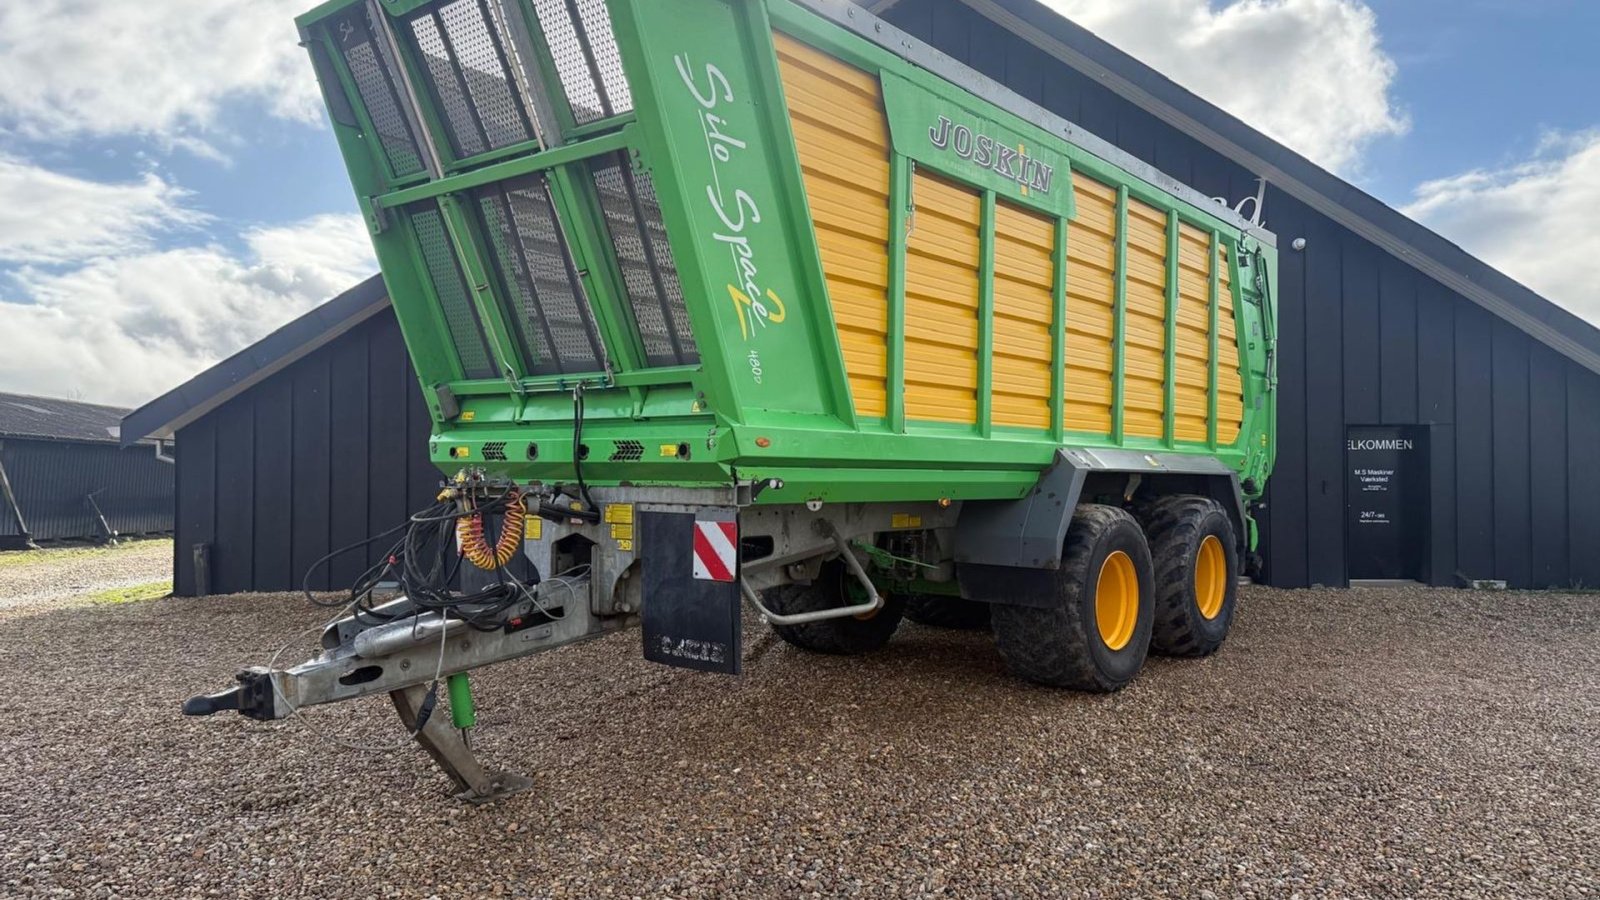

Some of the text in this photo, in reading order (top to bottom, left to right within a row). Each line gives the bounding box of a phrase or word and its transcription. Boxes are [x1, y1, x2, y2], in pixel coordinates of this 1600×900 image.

[928, 115, 1053, 192] JOSKIN
[674, 53, 768, 329] Silo Space
[727, 283, 786, 341] 2
[747, 350, 763, 385] 4800
